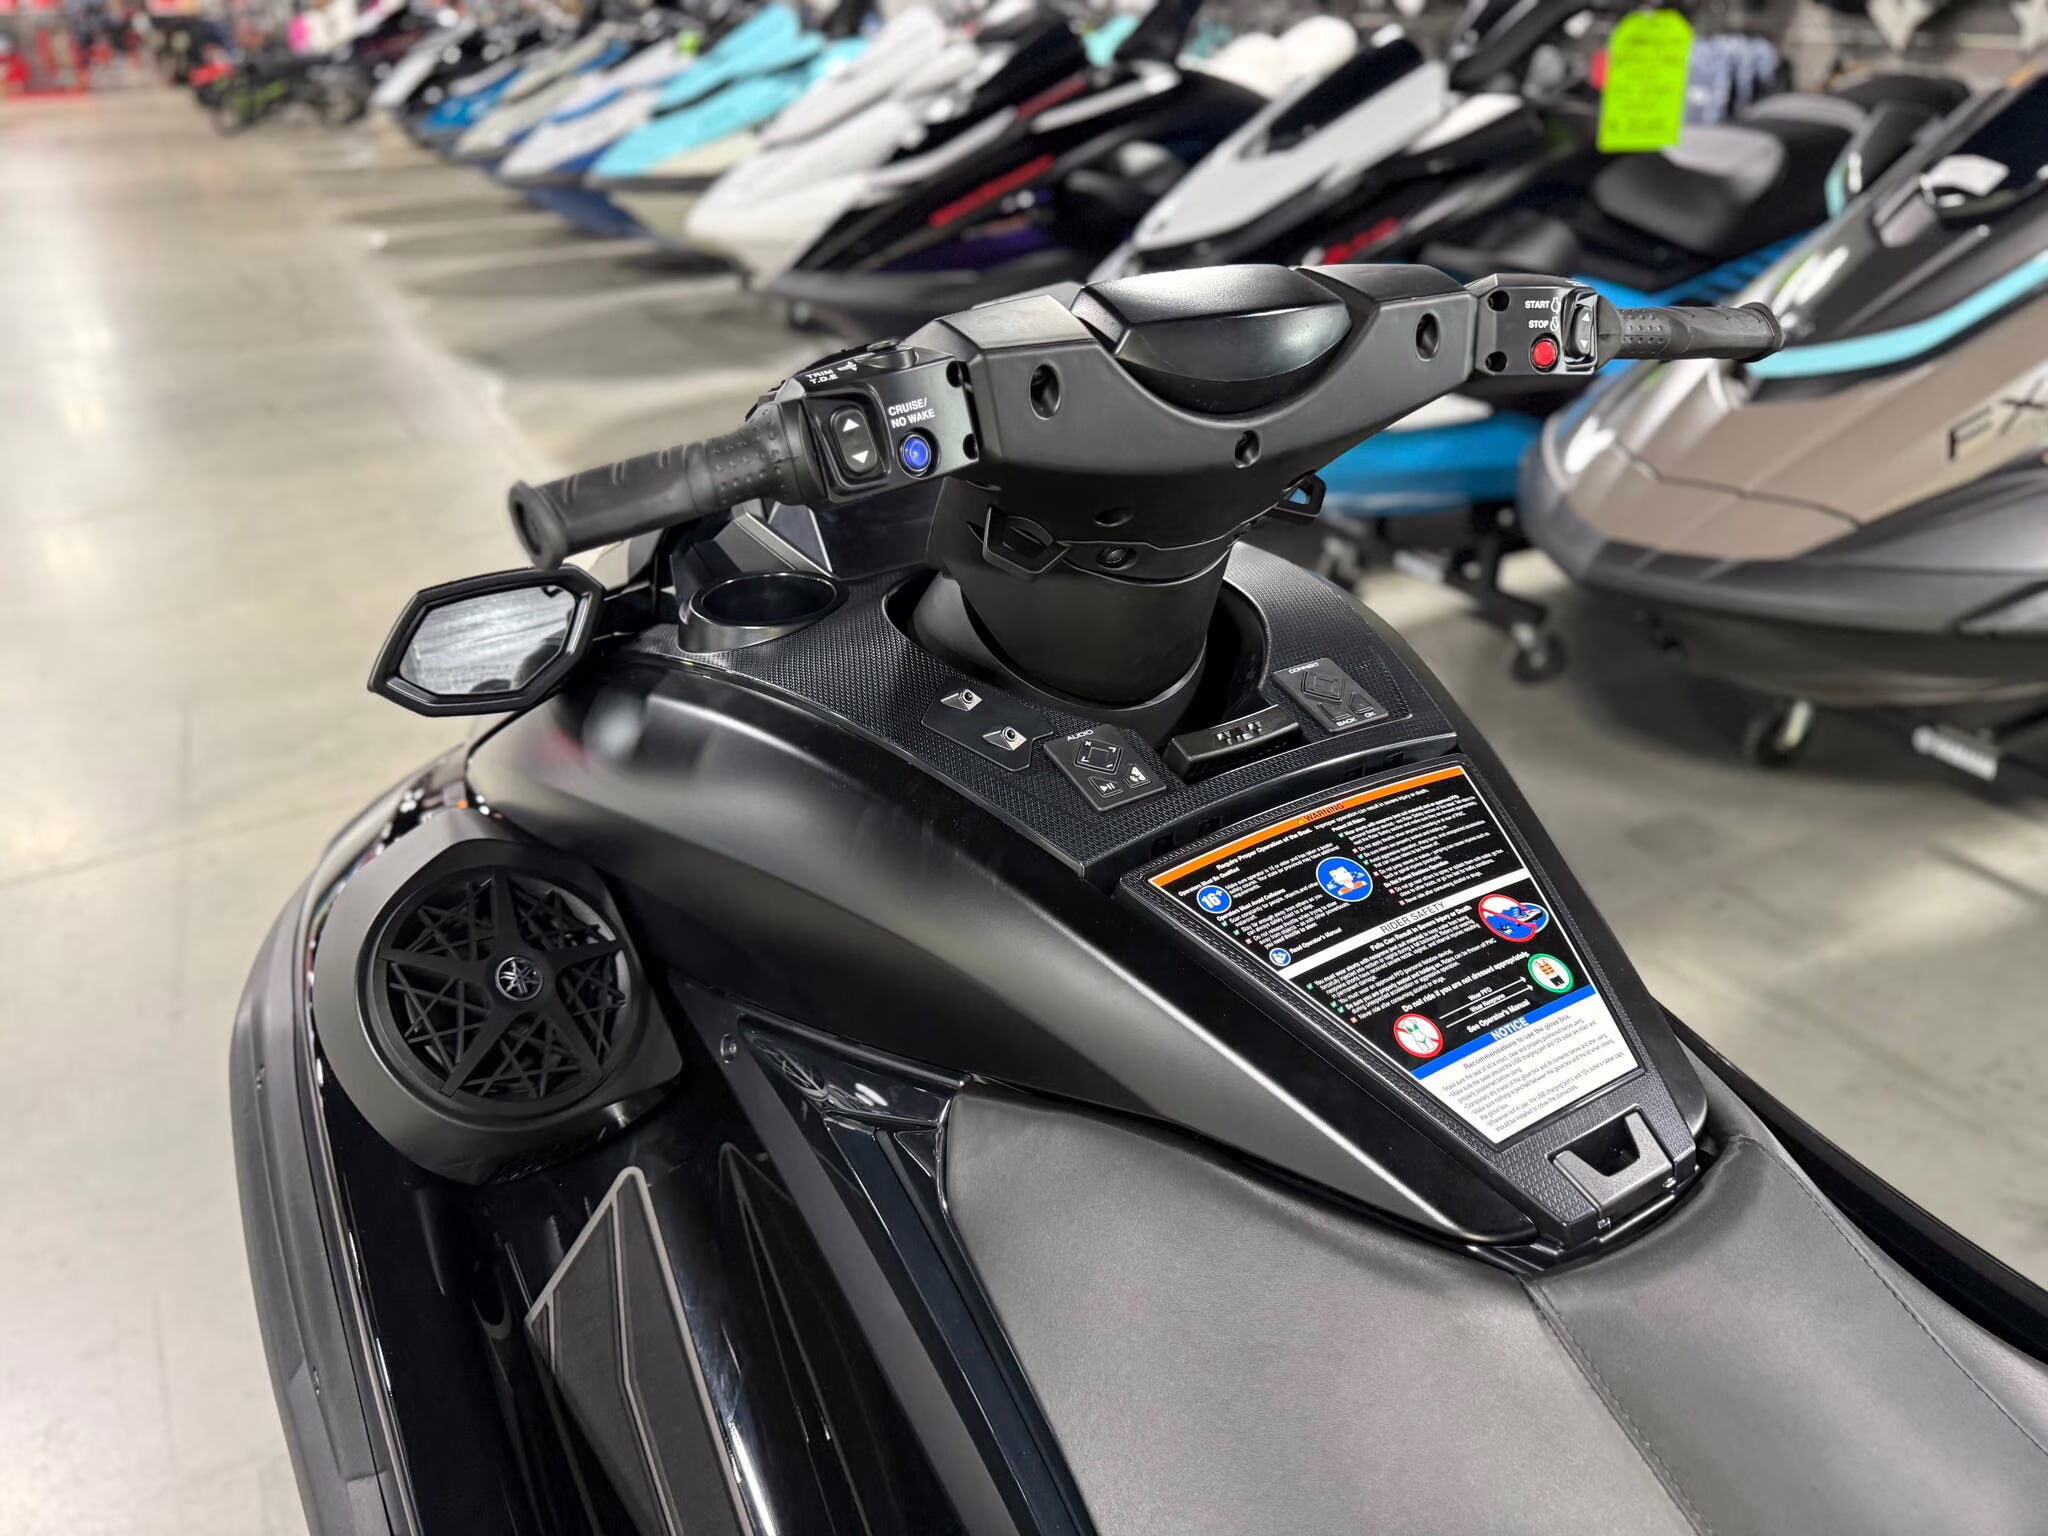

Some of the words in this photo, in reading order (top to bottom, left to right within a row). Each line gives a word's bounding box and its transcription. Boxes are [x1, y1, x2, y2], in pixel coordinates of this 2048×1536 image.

[1525, 301, 1550, 309] START
[1528, 320, 1549, 328] STOP
[805, 369, 834, 379] TRIM
[888, 397, 928, 416] CRUISE/
[891, 417, 907, 429] NO
[908, 410, 935, 425] WAKE
[1336, 717, 1357, 727] BACK
[1067, 729, 1094, 741] AUDIO
[1303, 803, 1344, 821] WARNING
[1216, 858, 1238, 870] Require
[1237, 850, 1256, 861] Proper
[1256, 840, 1283, 853] Operation
[1178, 884, 1202, 896] Operators
[1200, 878, 1214, 886] Must
[1219, 867, 1240, 878] Qualified
[1201, 889, 1222, 909] 16+
[1216, 909, 1240, 921] Operators
[1239, 903, 1252, 911] Must
[1251, 897, 1265, 906] Avoid
[1263, 889, 1286, 900] Collisions
[1370, 942, 1385, 951] Falls
[1383, 937, 1396, 945] Can
[1394, 929, 1413, 940] Result
[1417, 920, 1436, 930] Severe
[1434, 914, 1451, 923] Injury
[1455, 905, 1472, 914] Death
[1380, 917, 1411, 933] RIDER
[1410, 902, 1444, 920] SAFETY
[1289, 945, 1303, 953] Read
[1302, 935, 1326, 948] Operator's
[1324, 927, 1342, 937] Manual
[1401, 1004, 1413, 1012] Do
[1412, 998, 1424, 1007] not
[1423, 994, 1436, 1002] ride
[1440, 986, 1452, 995] you
[1451, 981, 1462, 989] are
[1461, 976, 1473, 984] not
[1471, 966, 1495, 980] dressed
[1468, 992, 1481, 1001] Wear
[1480, 987, 1492, 995] PFD
[1467, 1024, 1480, 1033] See
[1479, 1010, 1510, 1026] Operator's
[1507, 999, 1530, 1013] Manual
[1491, 1017, 1528, 1040] NOTICE
[1463, 1041, 1517, 1069] Recommendations
[1544, 1020, 1559, 1030] glove
